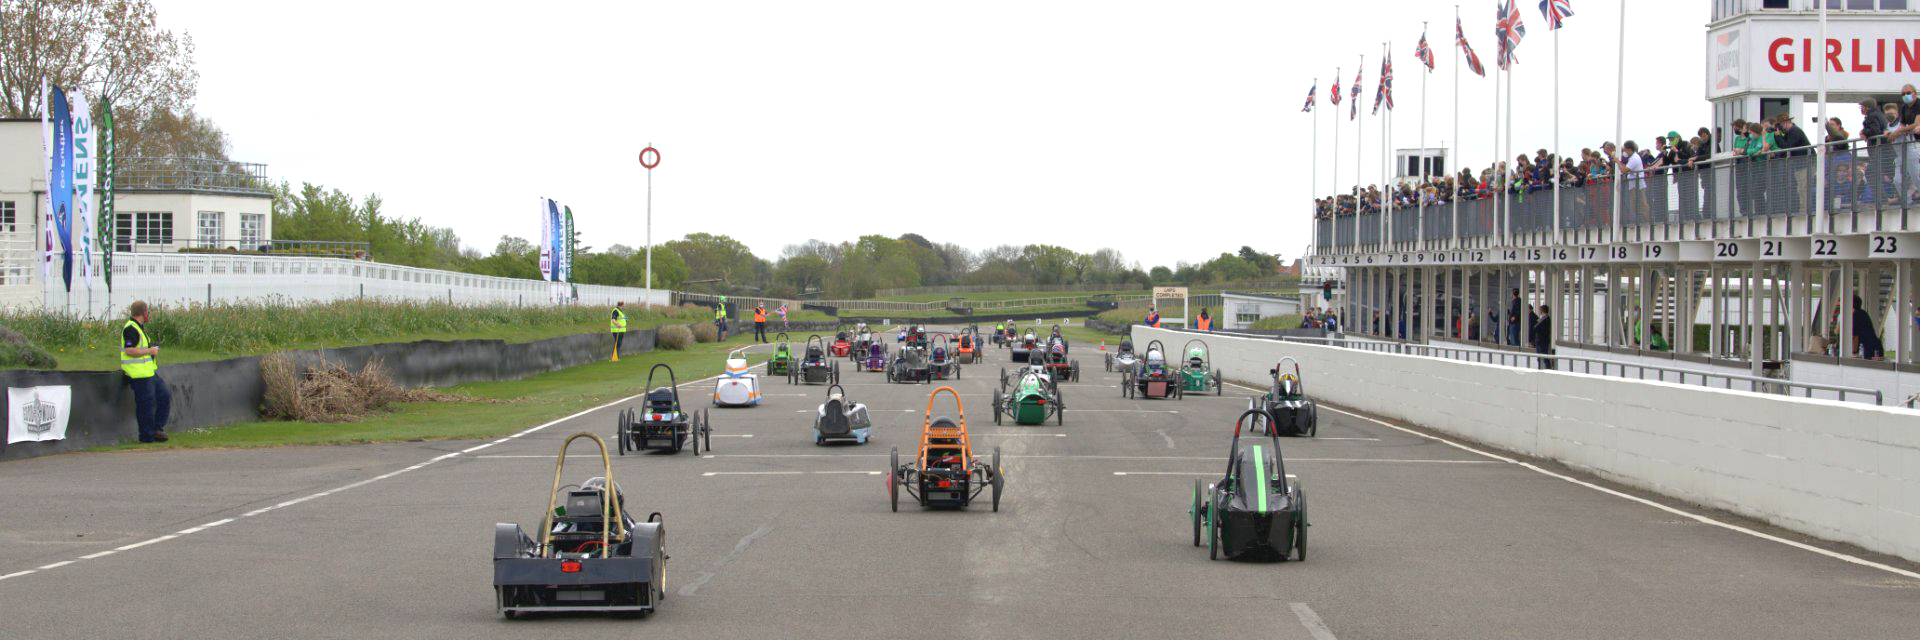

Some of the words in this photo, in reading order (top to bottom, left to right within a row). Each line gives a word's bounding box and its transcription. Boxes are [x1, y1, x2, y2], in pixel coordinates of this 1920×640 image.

[1717, 242, 1738, 257] 20
[1763, 241, 1782, 256] 21
[1814, 239, 1837, 255] 22
[1873, 236, 1897, 253] 23
[1471, 252, 1483, 262] 12
[1503, 250, 1516, 260] 14
[1528, 249, 1541, 260] 15
[1553, 249, 1567, 260] 16
[1581, 247, 1596, 259] 17
[1612, 246, 1627, 259] 18
[1645, 245, 1661, 258] 19
[1388, 255, 1393, 263] 7
[1402, 254, 1408, 262] 8
[1418, 253, 1424, 262] 9
[1433, 253, 1445, 262] 10
[1452, 253, 1462, 262] 11
